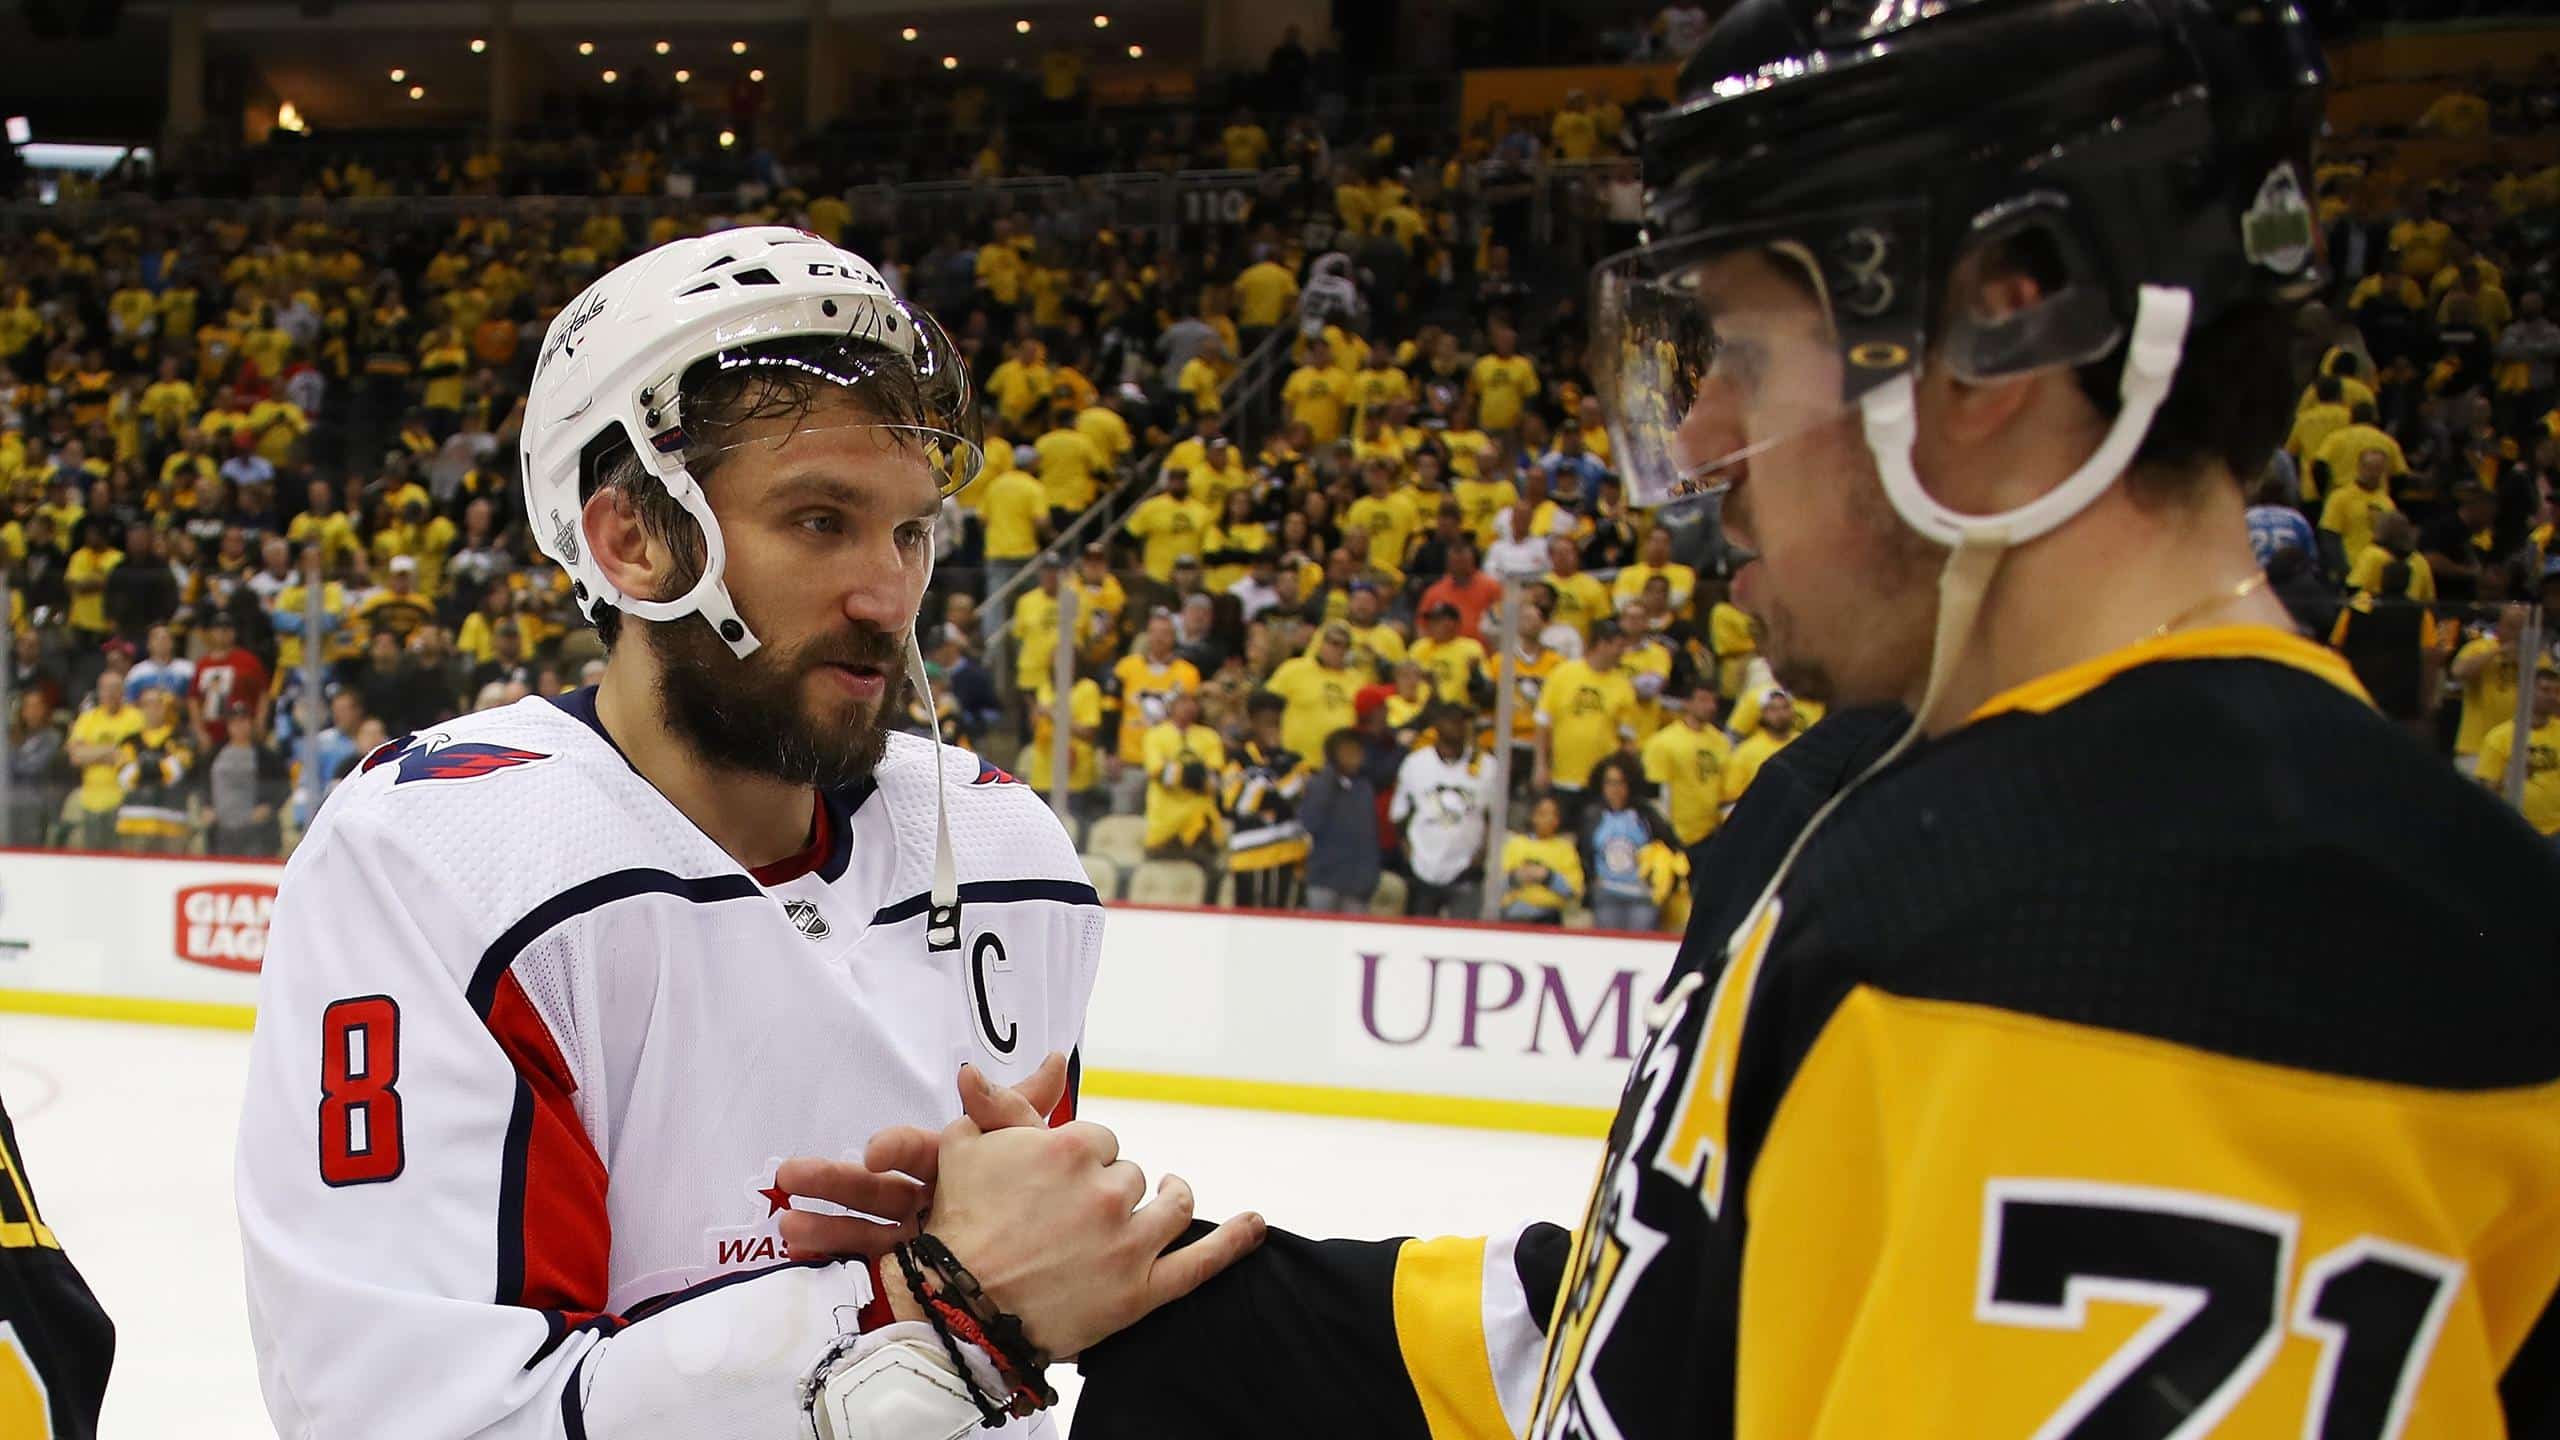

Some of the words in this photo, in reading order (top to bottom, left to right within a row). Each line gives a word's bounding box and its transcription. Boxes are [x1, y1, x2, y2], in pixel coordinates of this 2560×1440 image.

[1185, 189, 1247, 222] 110
[972, 931, 1018, 1054] C
[1355, 951, 1661, 1060] UPM
[1653, 897, 1782, 1222] A
[319, 994, 405, 1188] 8
[1975, 1177, 2467, 1440] 71
